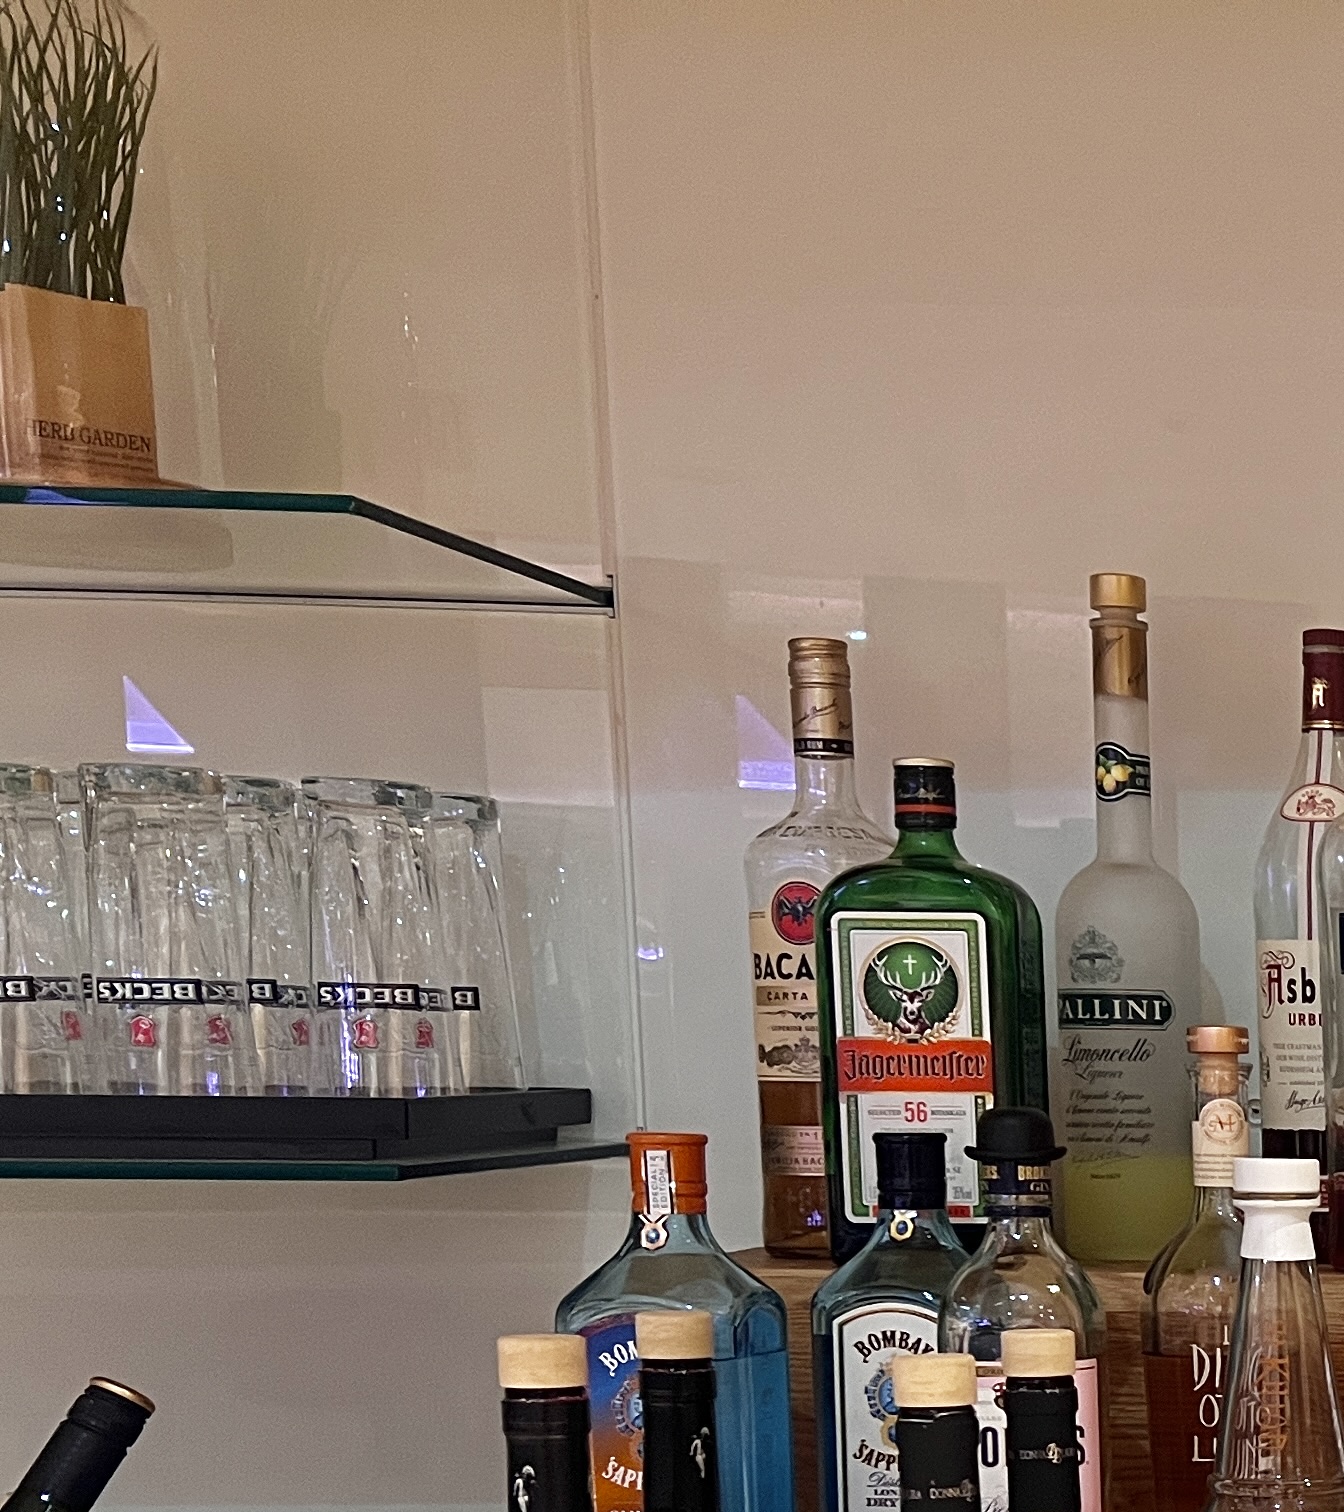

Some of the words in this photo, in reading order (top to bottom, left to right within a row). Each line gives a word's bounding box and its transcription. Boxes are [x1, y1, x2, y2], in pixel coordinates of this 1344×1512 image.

[79, 427, 150, 452] GARDEN
[767, 992, 808, 1001] CARTA
[1288, 1012, 1322, 1026] URB
[1062, 1034, 1156, 1062] Limoncello
[904, 1101, 928, 1123] 56
[866, 1498, 898, 1508] DRY
